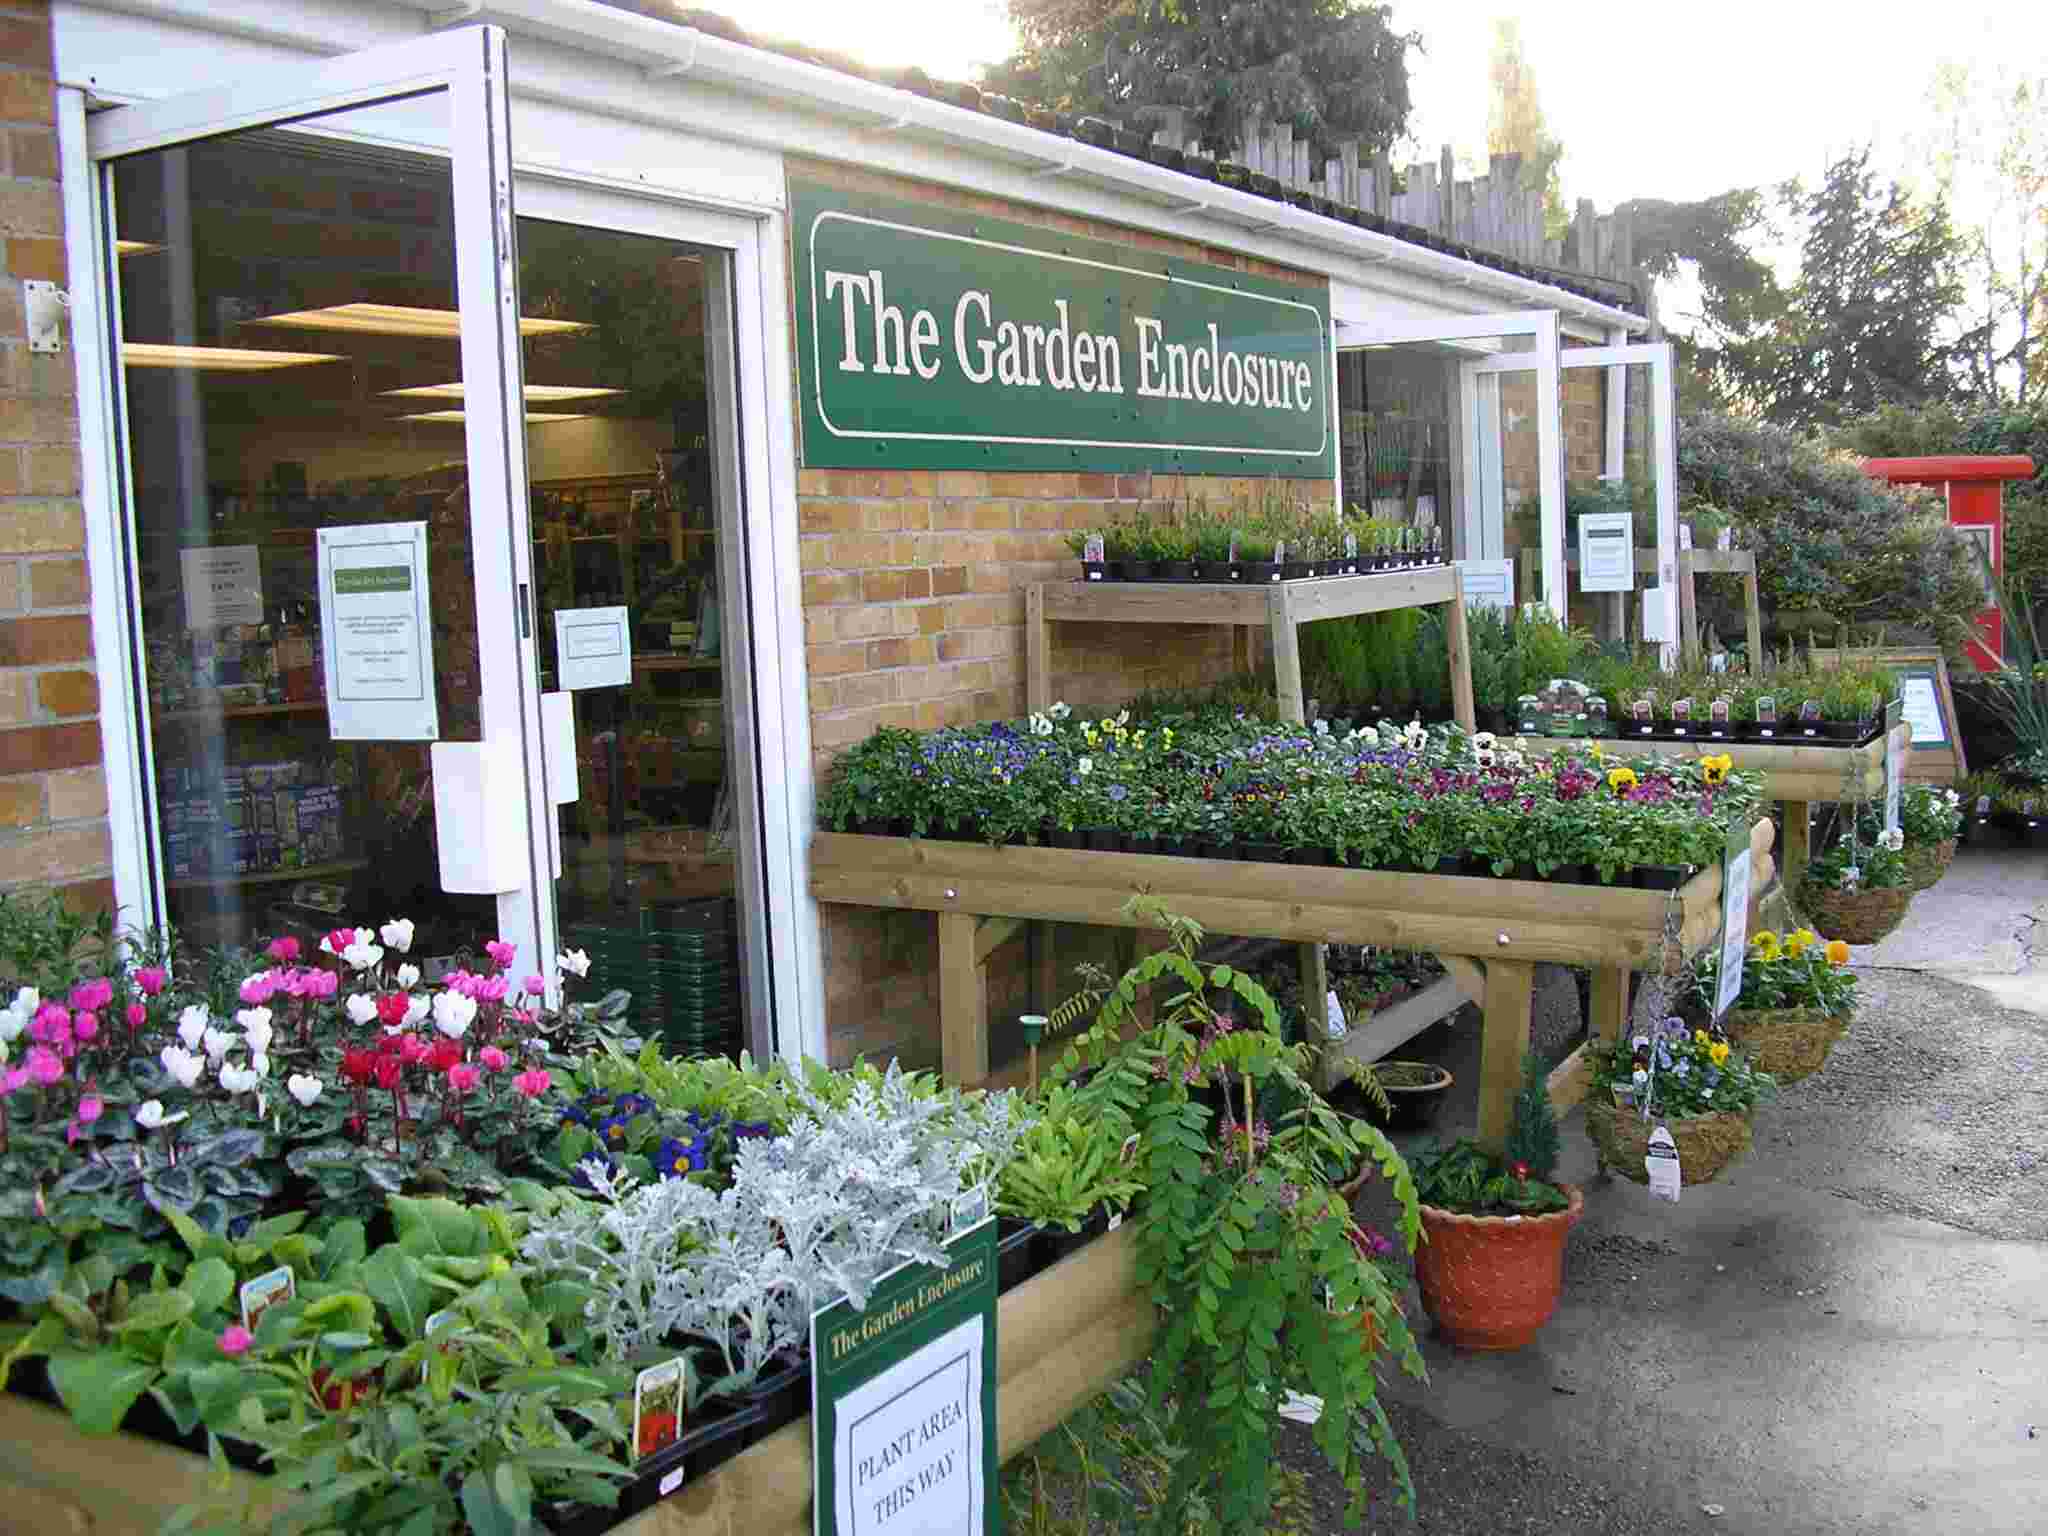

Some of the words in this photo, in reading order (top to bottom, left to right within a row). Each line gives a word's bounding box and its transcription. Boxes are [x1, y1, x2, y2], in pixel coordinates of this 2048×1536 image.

[825, 269, 941, 379] The
[953, 289, 1124, 394] Garden
[1133, 315, 1312, 412] Enclosure
[831, 1330, 860, 1360] The
[862, 1297, 915, 1340] Garden
[917, 1259, 984, 1309] Enclosure
[857, 1429, 915, 1487] PLANT
[919, 1399, 962, 1448] AREA
[873, 1479, 915, 1525] THIS
[918, 1449, 955, 1493] WAY
